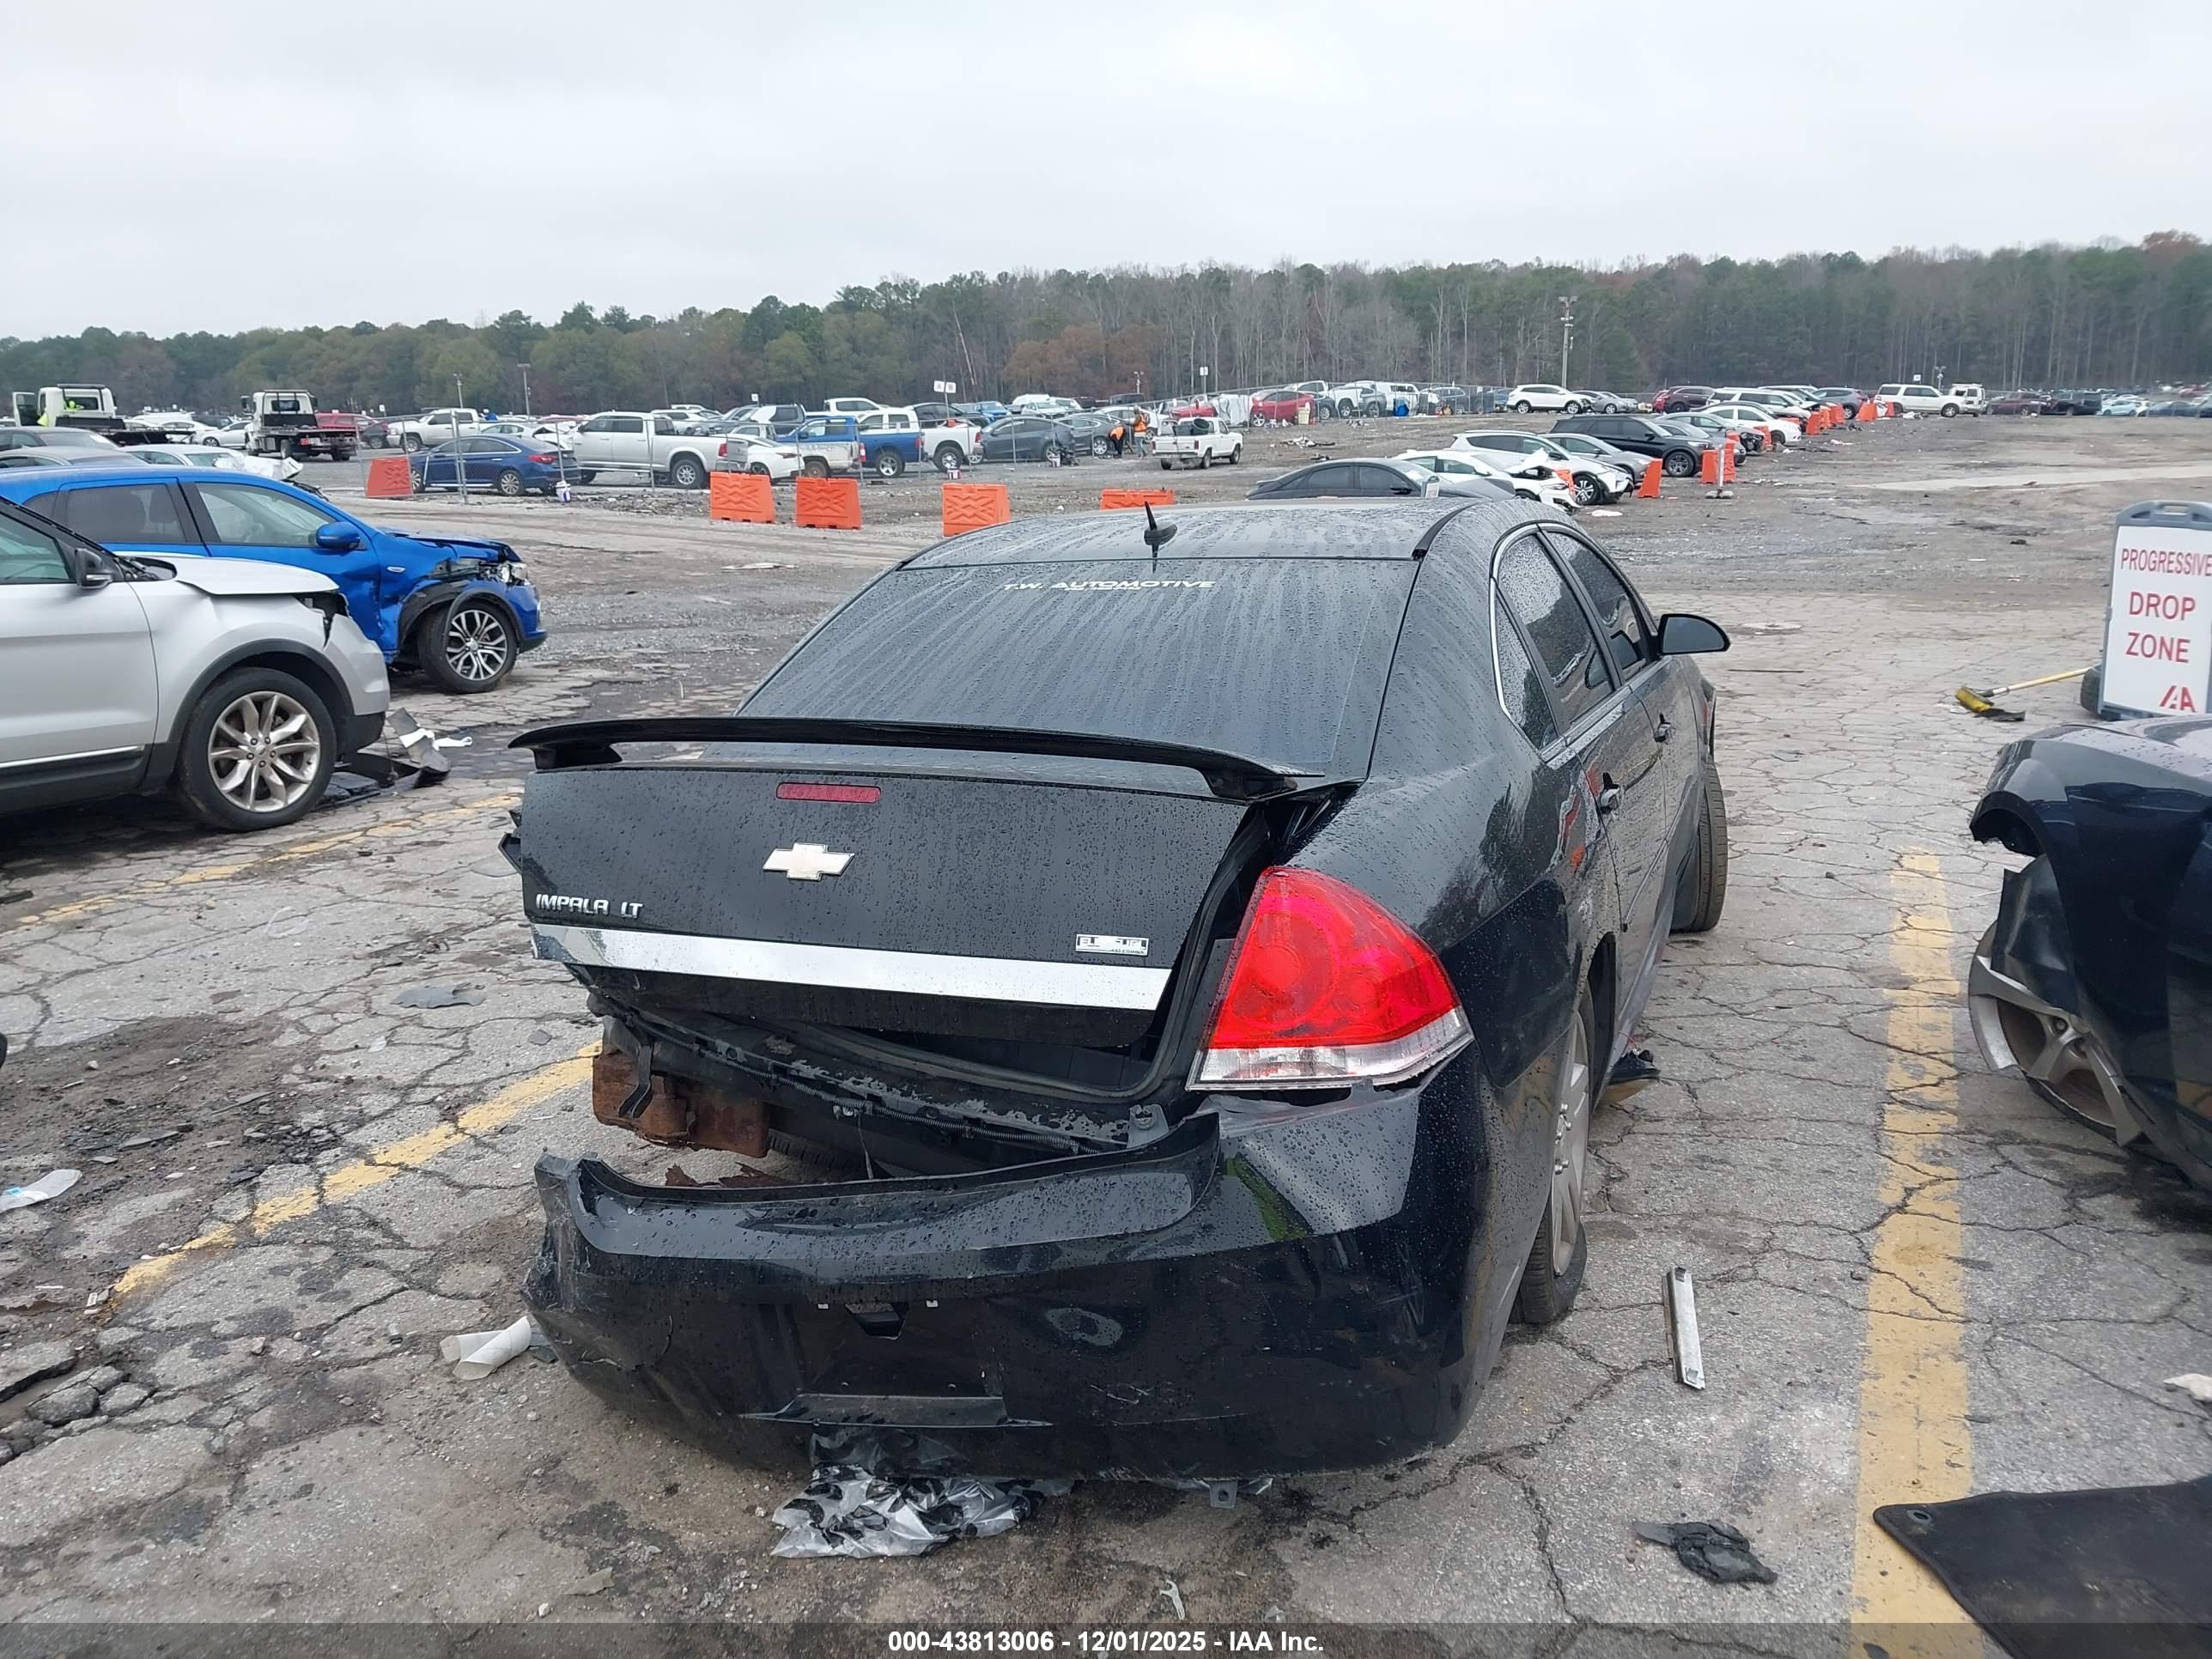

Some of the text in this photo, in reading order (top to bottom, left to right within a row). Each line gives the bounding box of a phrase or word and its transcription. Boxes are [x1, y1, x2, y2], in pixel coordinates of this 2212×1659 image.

[2120, 548, 2212, 576] PROGRESSIVE
[1049, 580, 1217, 590] AUTOMOTIVE
[2129, 591, 2197, 621] DROP
[2125, 631, 2191, 664] ZONE
[536, 893, 644, 919] IMPALA LT
